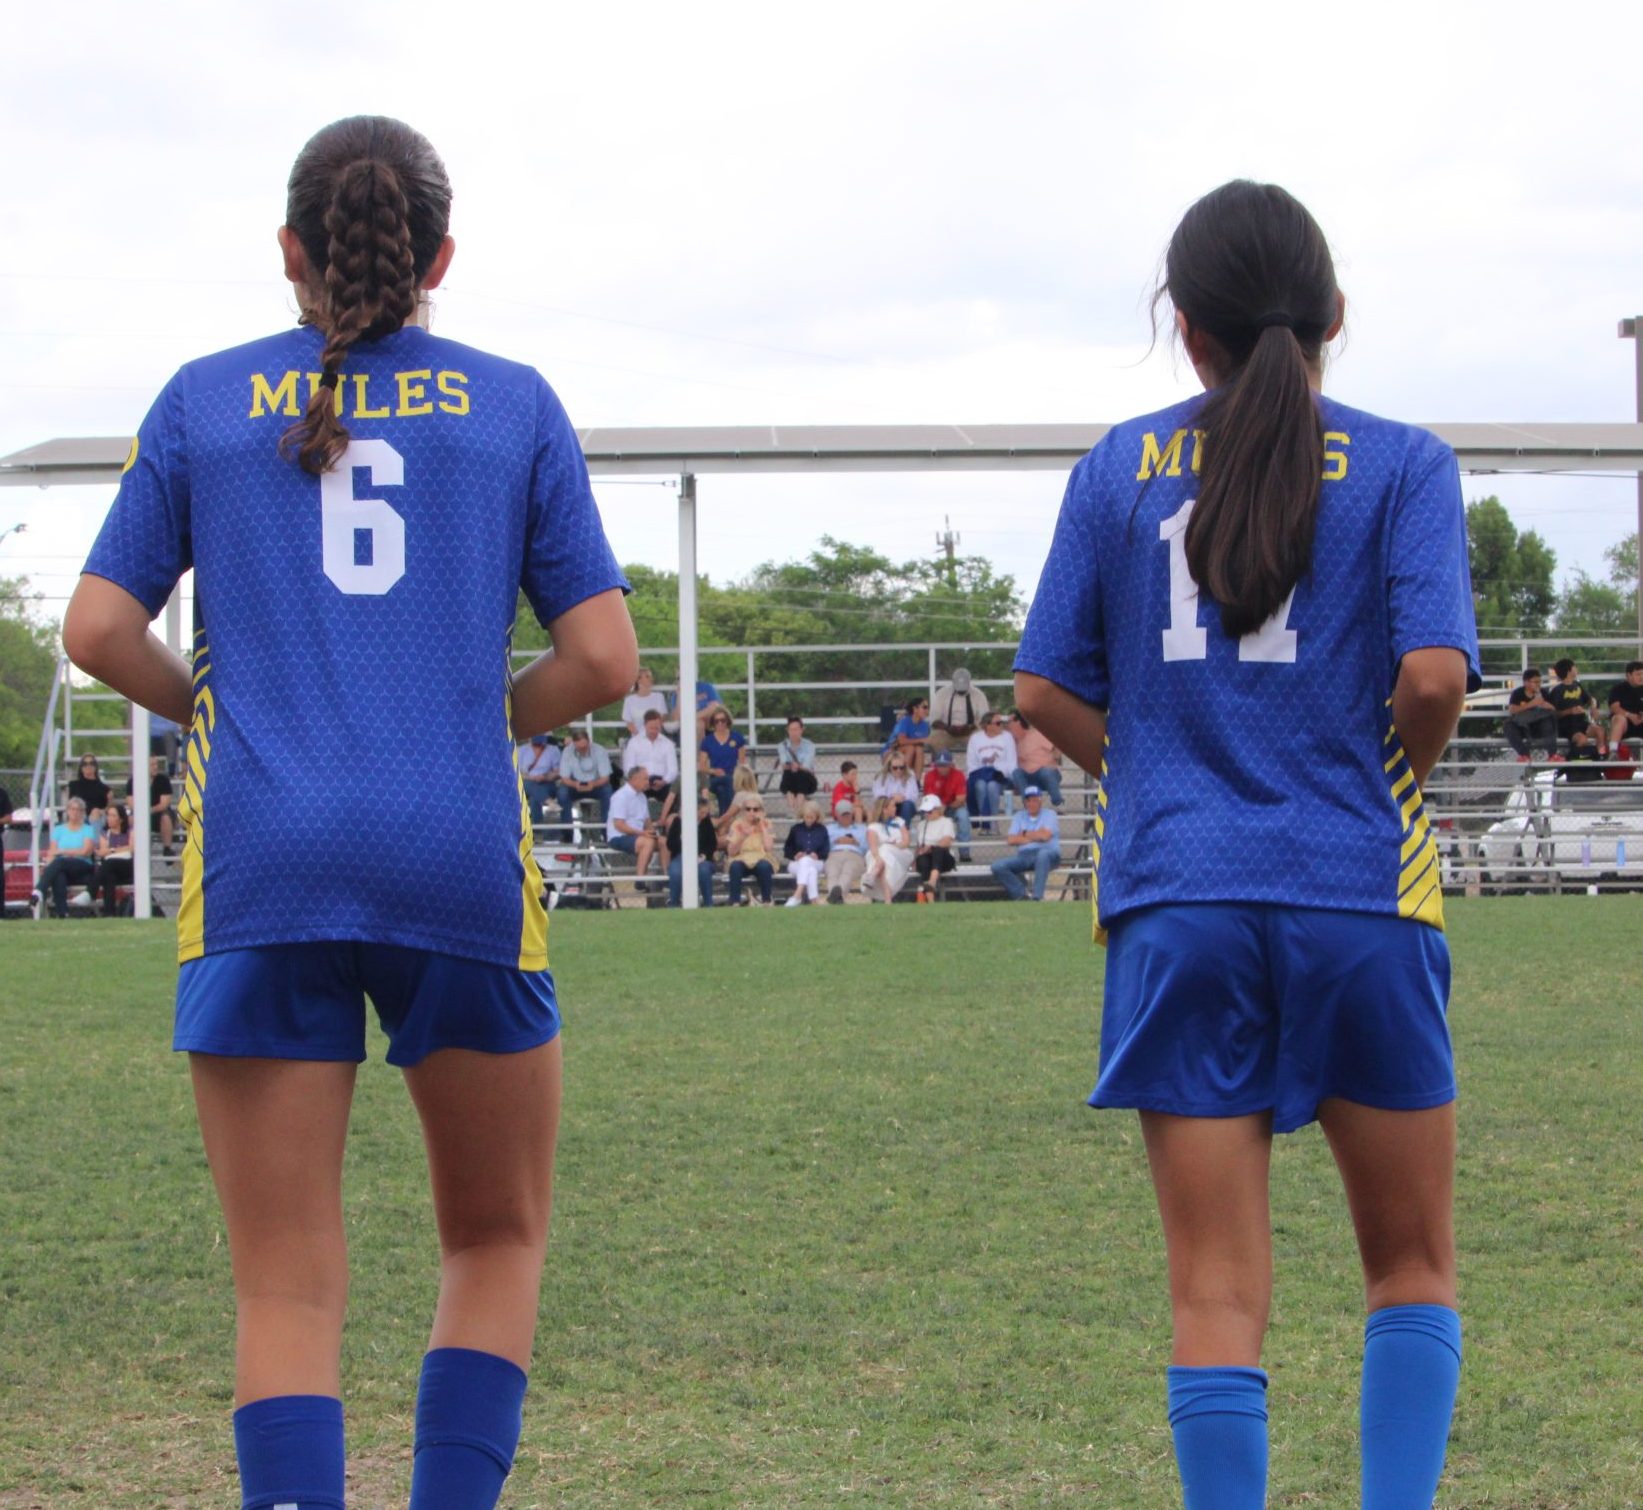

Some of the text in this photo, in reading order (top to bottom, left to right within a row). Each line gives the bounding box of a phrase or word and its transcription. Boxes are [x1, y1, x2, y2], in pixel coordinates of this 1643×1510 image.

[249, 370, 470, 418] MULES
[1136, 428, 1350, 480] MUS
[321, 439, 405, 595] 6
